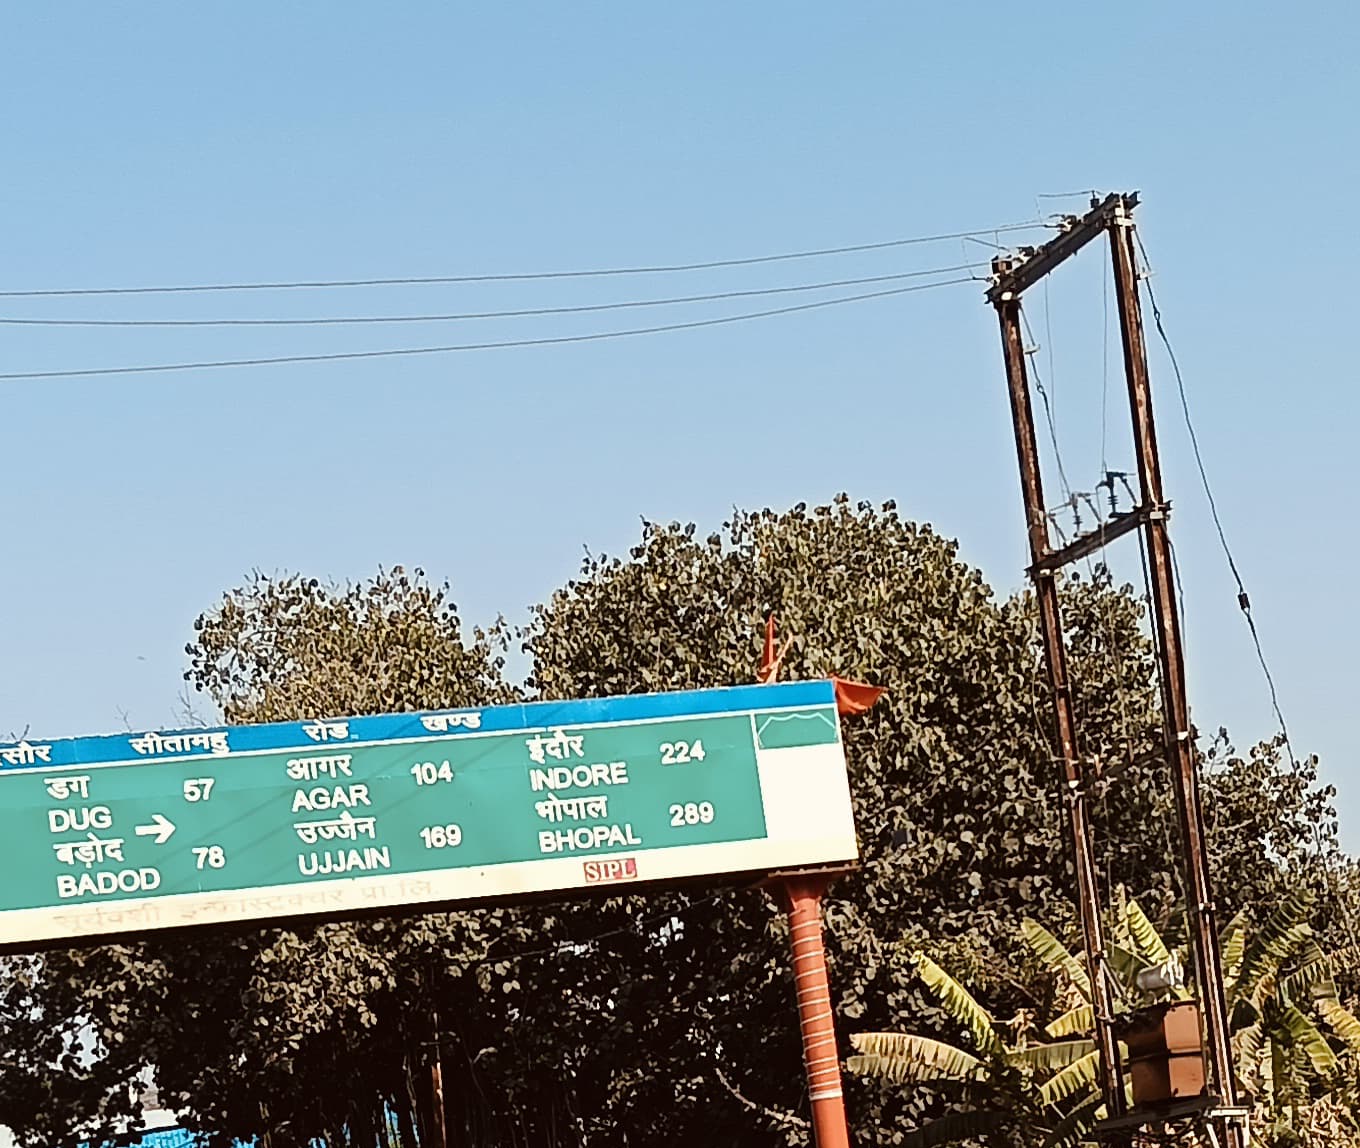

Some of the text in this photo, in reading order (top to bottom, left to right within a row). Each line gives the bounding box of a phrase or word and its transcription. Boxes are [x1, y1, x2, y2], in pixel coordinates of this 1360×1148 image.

[302, 719, 349, 742] रोड
[420, 712, 482, 731] खण्ड
[660, 740, 706, 765] 224
[286, 754, 353, 780] आगर
[410, 760, 454, 786] 104
[529, 761, 629, 791] INDORE
[44, 775, 91, 800] डग
[183, 778, 215, 801] 57
[291, 784, 372, 812] AGAR
[48, 805, 113, 832] DUG
[534, 792, 608, 822] भोपाल
[669, 801, 715, 827] 289
[293, 810, 377, 844] उज्जैन
[419, 824, 462, 849] 169
[538, 823, 641, 853] BHOPAL
[53, 831, 125, 868] बड़ोद
[192, 845, 226, 870] 78
[298, 846, 390, 876] UJJAIN
[57, 867, 161, 898] BADOD
[584, 859, 637, 881] SIPL
